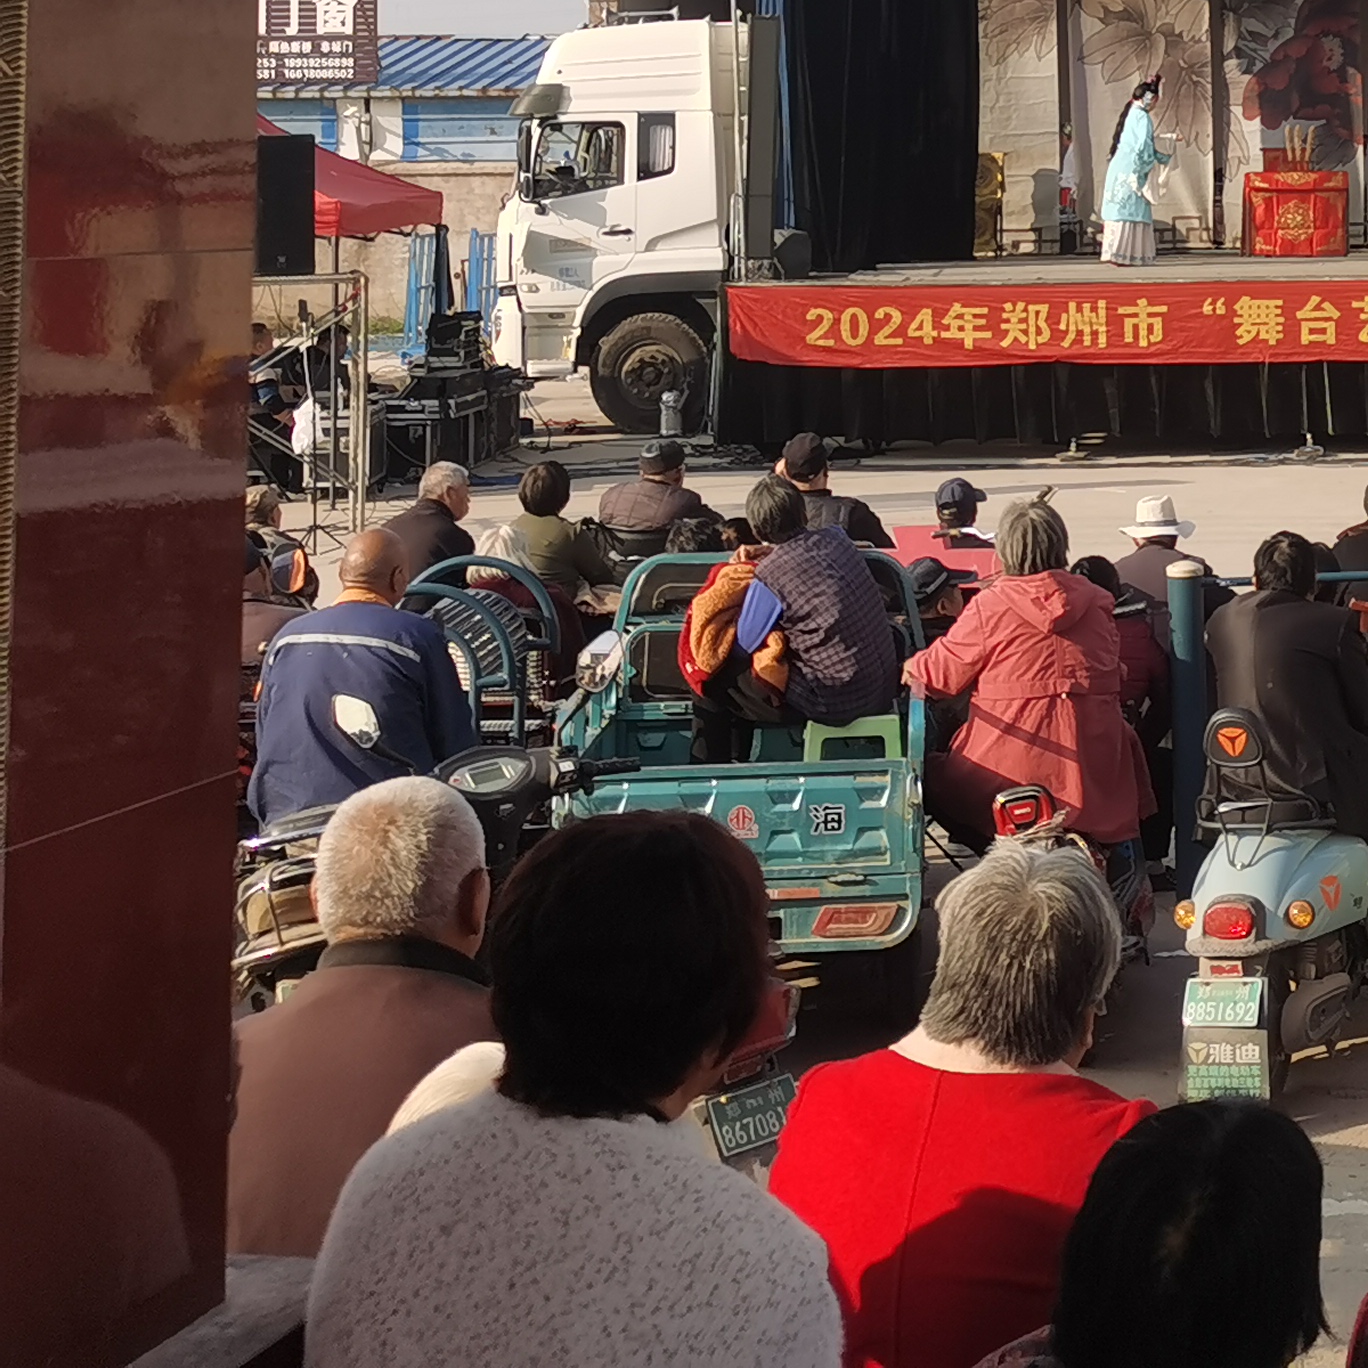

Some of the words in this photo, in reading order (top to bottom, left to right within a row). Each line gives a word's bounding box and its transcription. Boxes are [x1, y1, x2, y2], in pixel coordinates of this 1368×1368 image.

[810, 804, 844, 834] 海
[1187, 1001, 1256, 1021] 8851692
[1207, 1042, 1261, 1064] 雅迪
